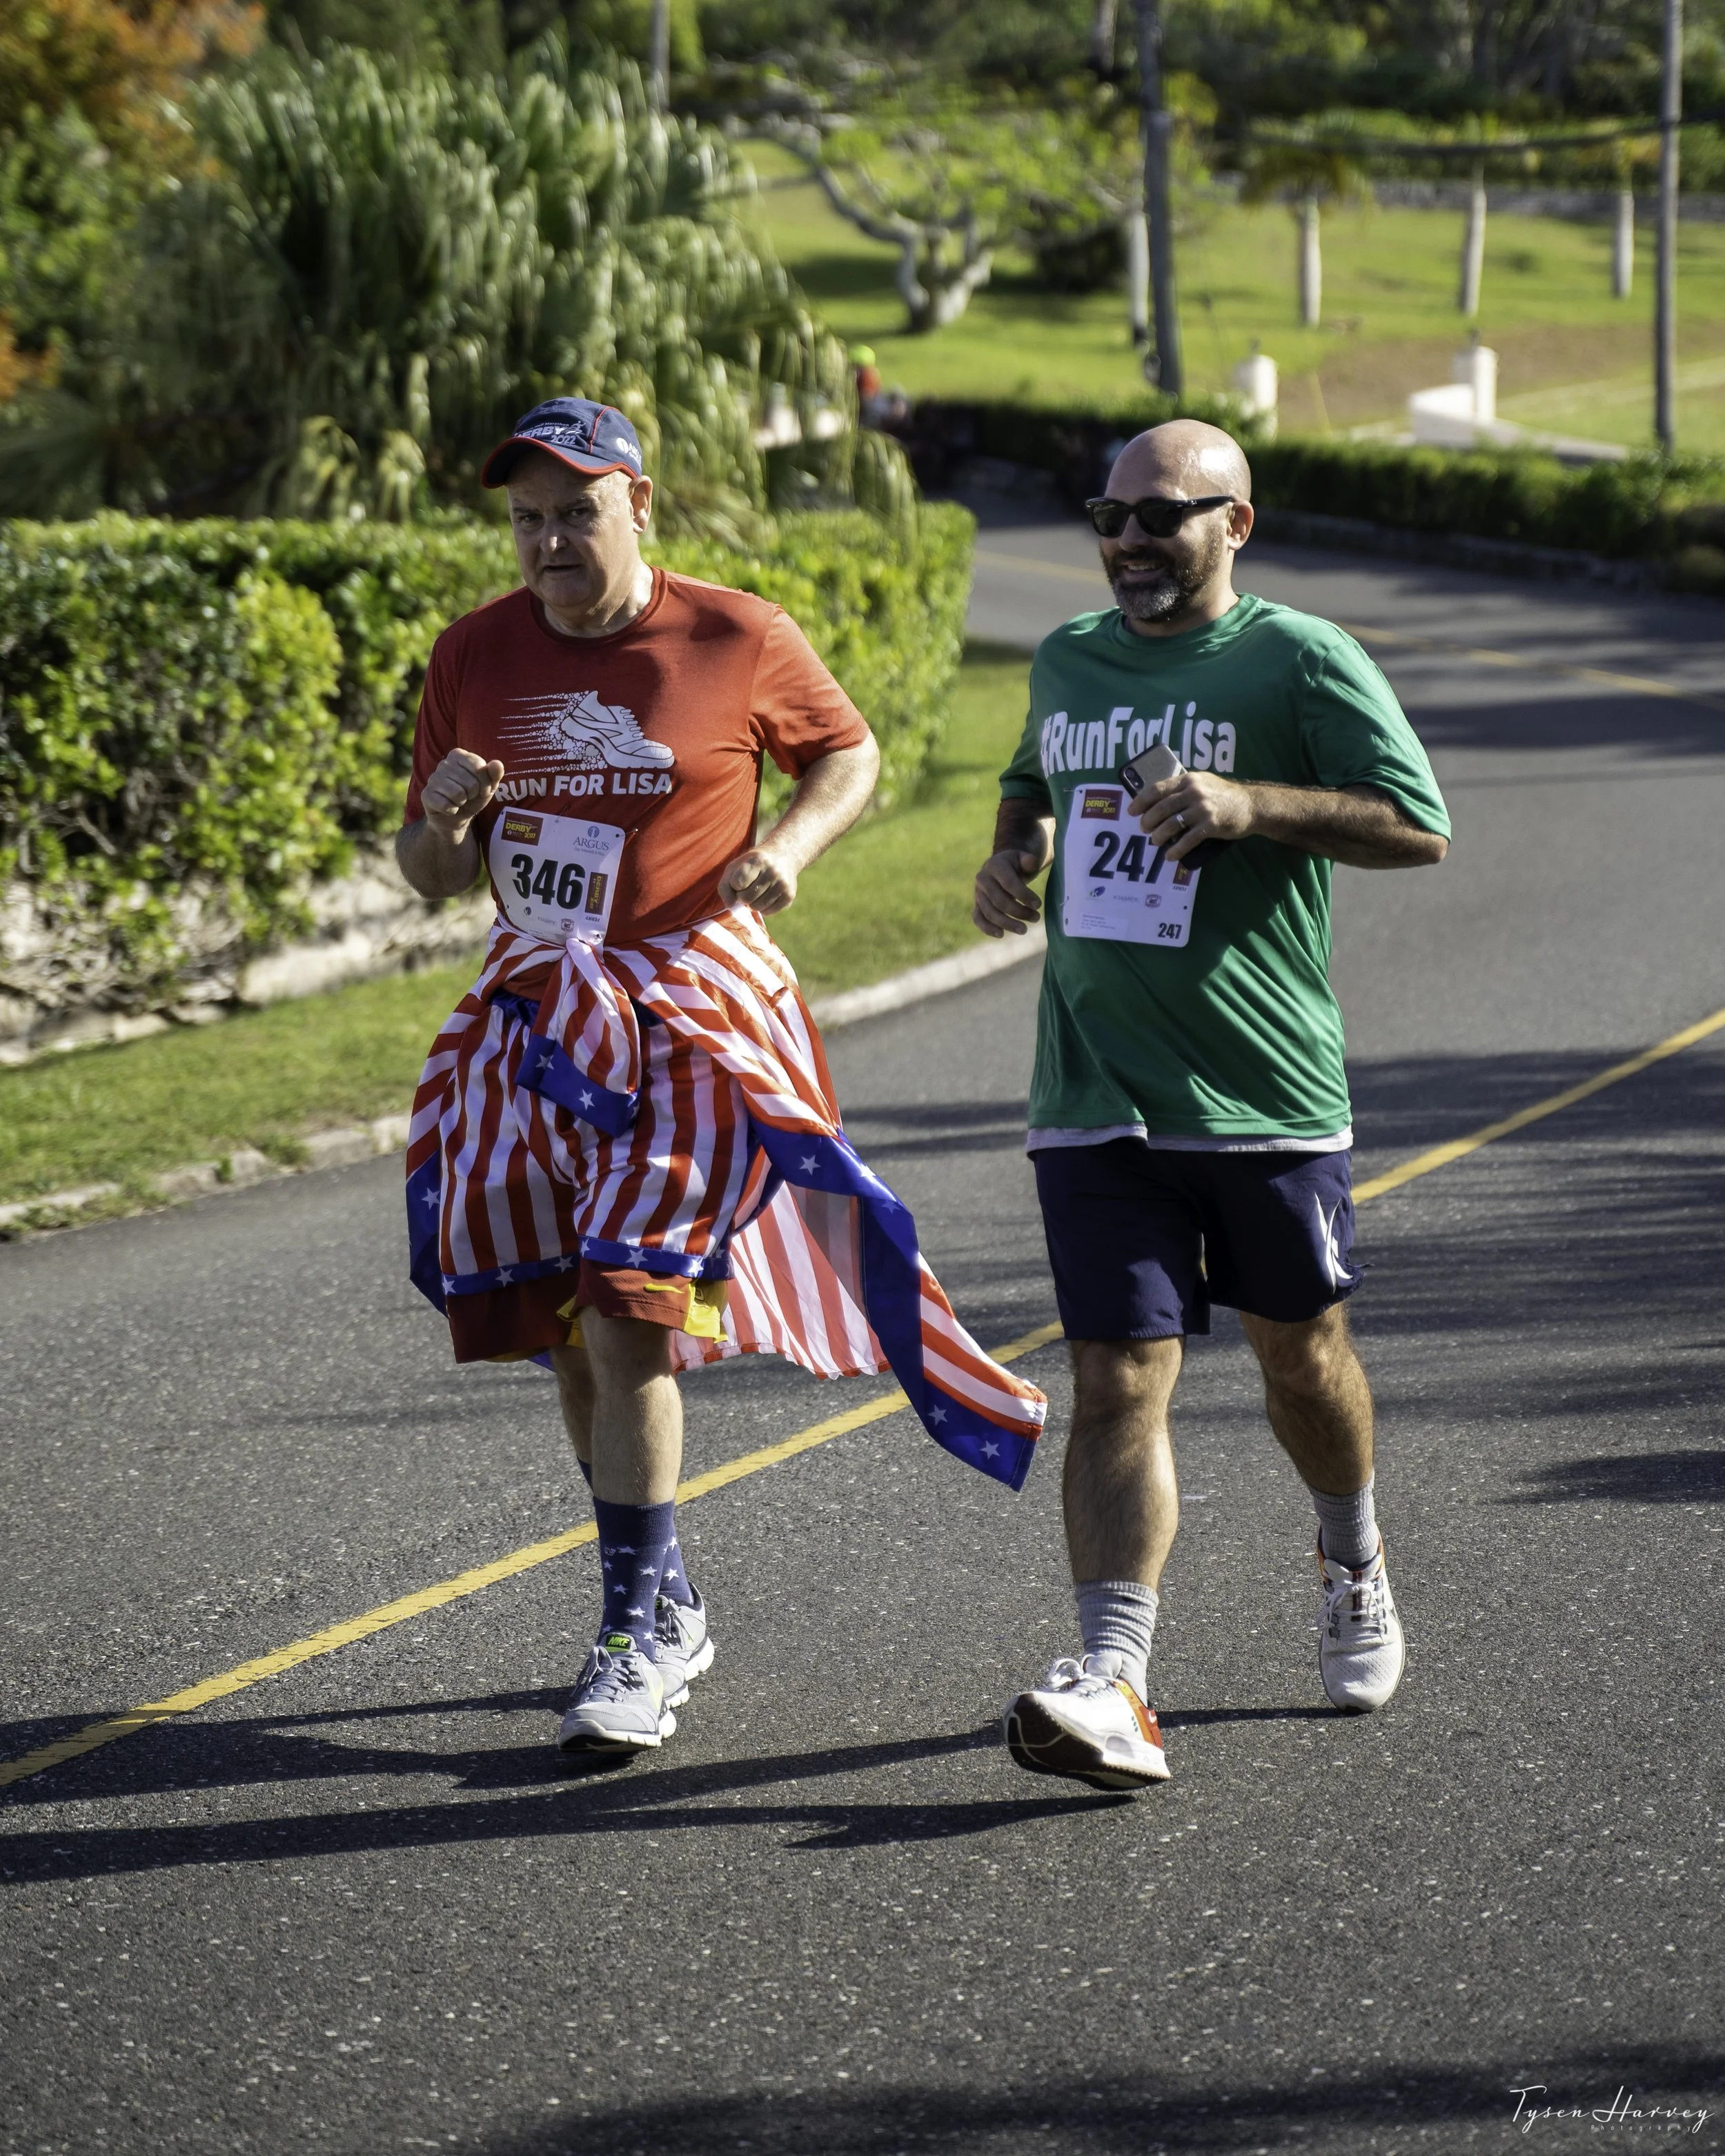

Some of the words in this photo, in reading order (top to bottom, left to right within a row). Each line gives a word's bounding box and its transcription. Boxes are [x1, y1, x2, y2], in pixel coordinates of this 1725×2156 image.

[551, 434, 576, 445] 2022
[1041, 701, 1236, 780] #RunForLisa
[495, 778, 547, 802] RUN
[553, 773, 604, 796] FOR
[612, 773, 673, 795] LISA
[505, 822, 531, 833] DERBY
[573, 836, 609, 851] ARGUS
[1089, 831, 1172, 884] 247
[511, 853, 585, 910] 346
[1158, 922, 1183, 940] 247
[608, 1636, 630, 1647] NIKE
